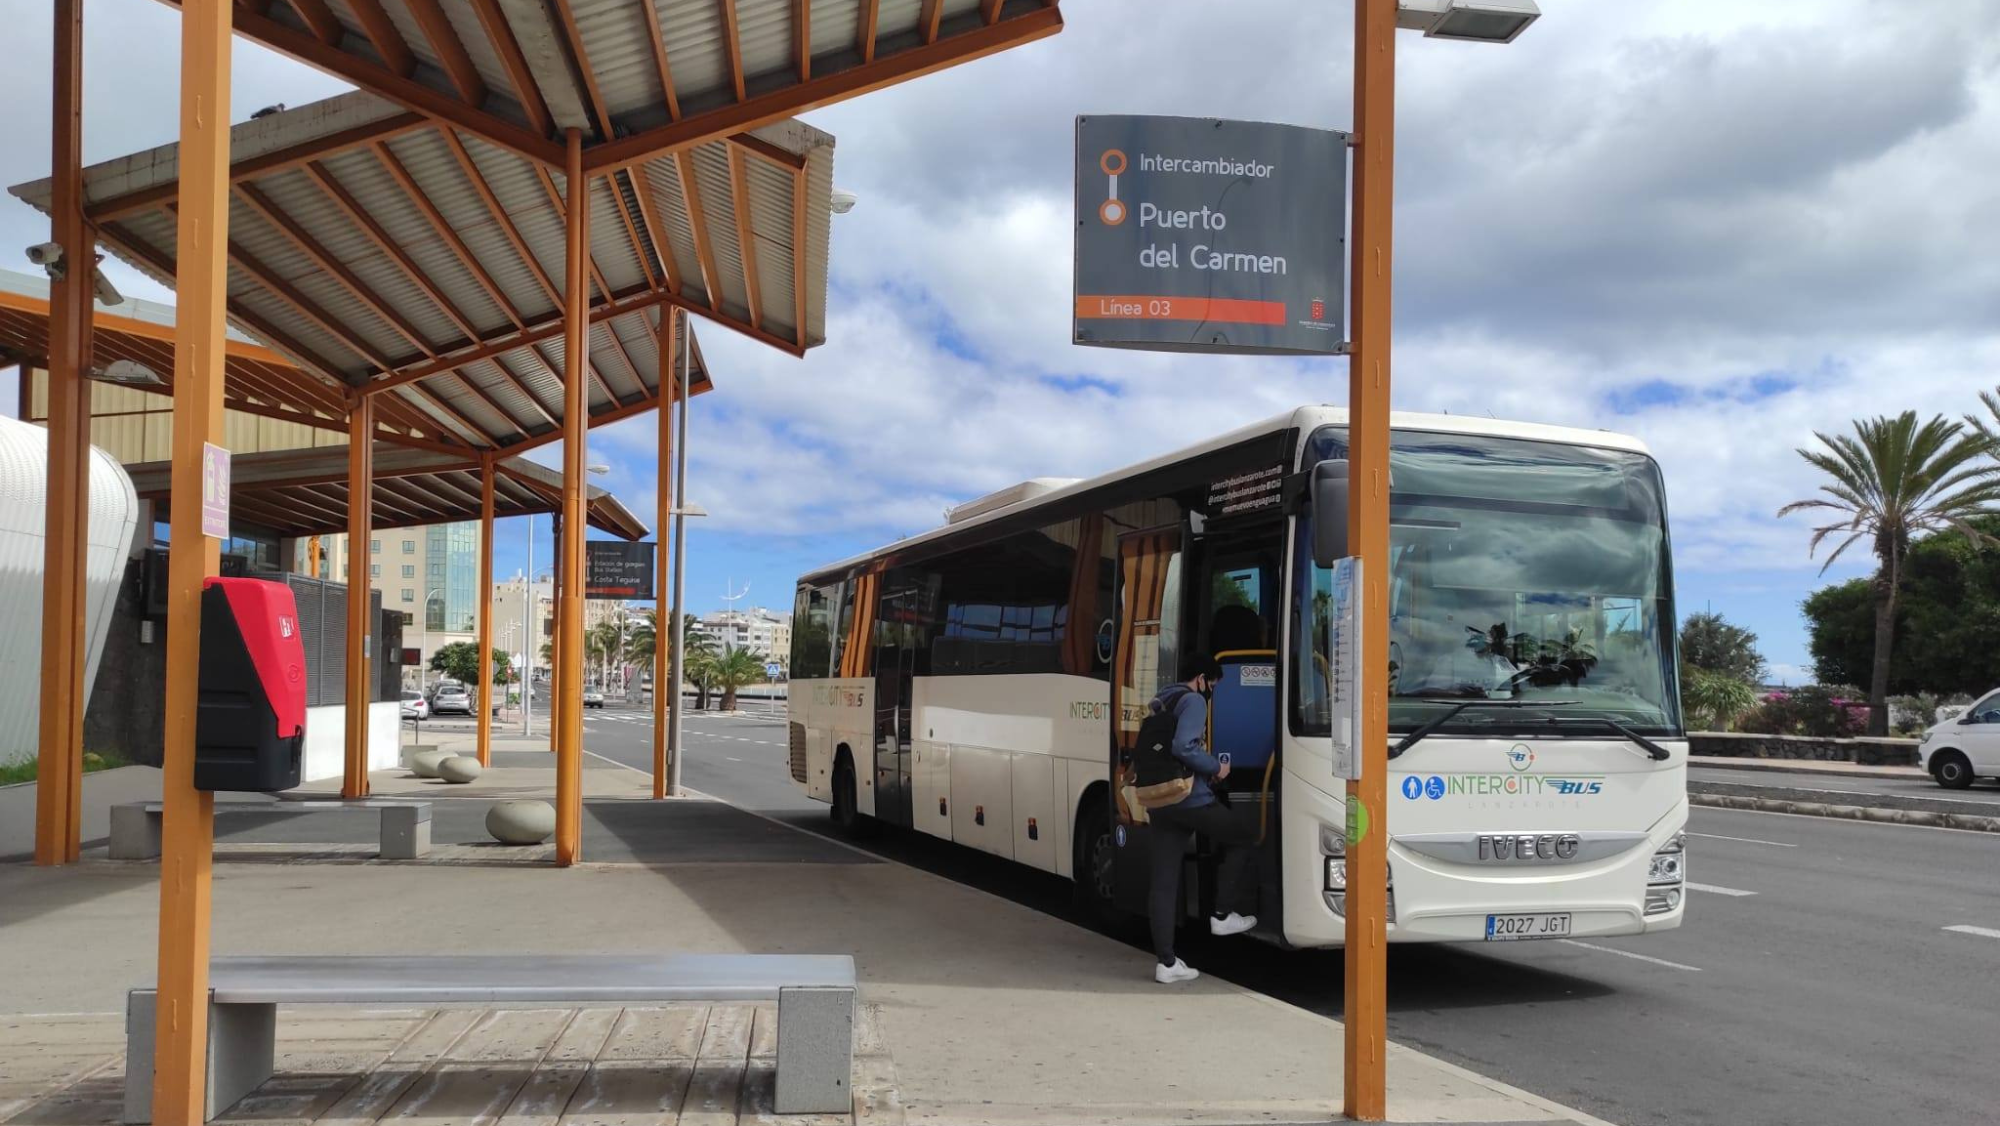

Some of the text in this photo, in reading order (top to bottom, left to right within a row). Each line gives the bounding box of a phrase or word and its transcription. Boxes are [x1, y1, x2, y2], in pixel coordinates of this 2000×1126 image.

[1140, 153, 1274, 178] Intercambiador
[1140, 202, 1226, 230] Puerto
[1139, 243, 1287, 275] del Carmen
[1100, 299, 1171, 316] Línea 03
[594, 575, 613, 583] Costa
[1447, 775, 1603, 795] INTERCITY BUS
[1478, 834, 1579, 860] IVECO
[1496, 916, 1568, 934] 2027 JGT
